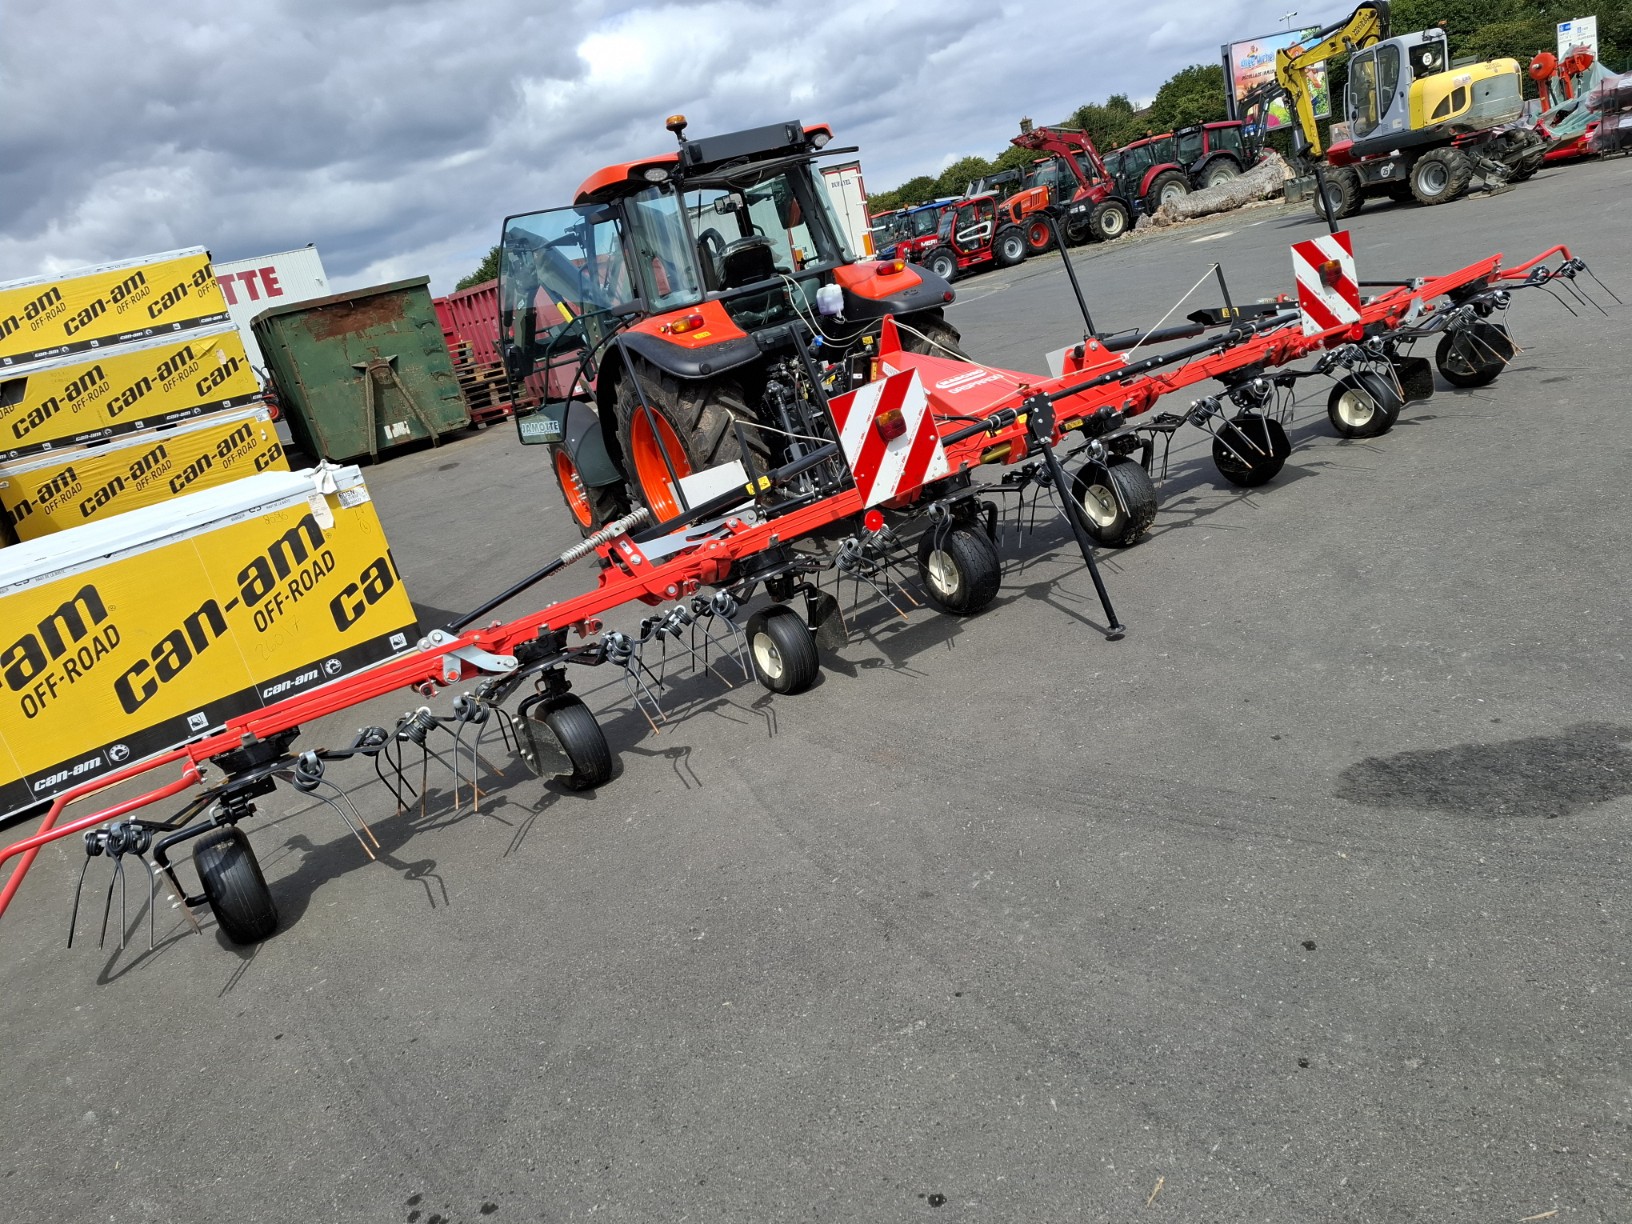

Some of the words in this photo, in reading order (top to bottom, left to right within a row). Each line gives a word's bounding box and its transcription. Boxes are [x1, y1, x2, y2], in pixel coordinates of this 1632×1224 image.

[63, 271, 146, 336] can-am
[117, 286, 151, 315] OFF-ROAD
[216, 266, 284, 305] TTE
[30, 302, 67, 332] OFF-ROAD
[106, 345, 195, 418] can-am
[163, 361, 199, 393] OFF-ROAD
[11, 365, 105, 440] can-am
[71, 381, 110, 414] OFF-ROAD
[168, 422, 253, 495] can-am
[222, 438, 257, 469] OFF-ROAD
[79, 444, 168, 518] can-am
[135, 459, 172, 492] OFF-ROAD
[44, 482, 83, 516] OFF-ROAD
[253, 549, 336, 633] OFF-ROAD
[113, 513, 325, 715] can-am
[20, 624, 121, 719] OFF-ROAD
[263, 668, 319, 699] can-am
[34, 755, 101, 792] can-am
